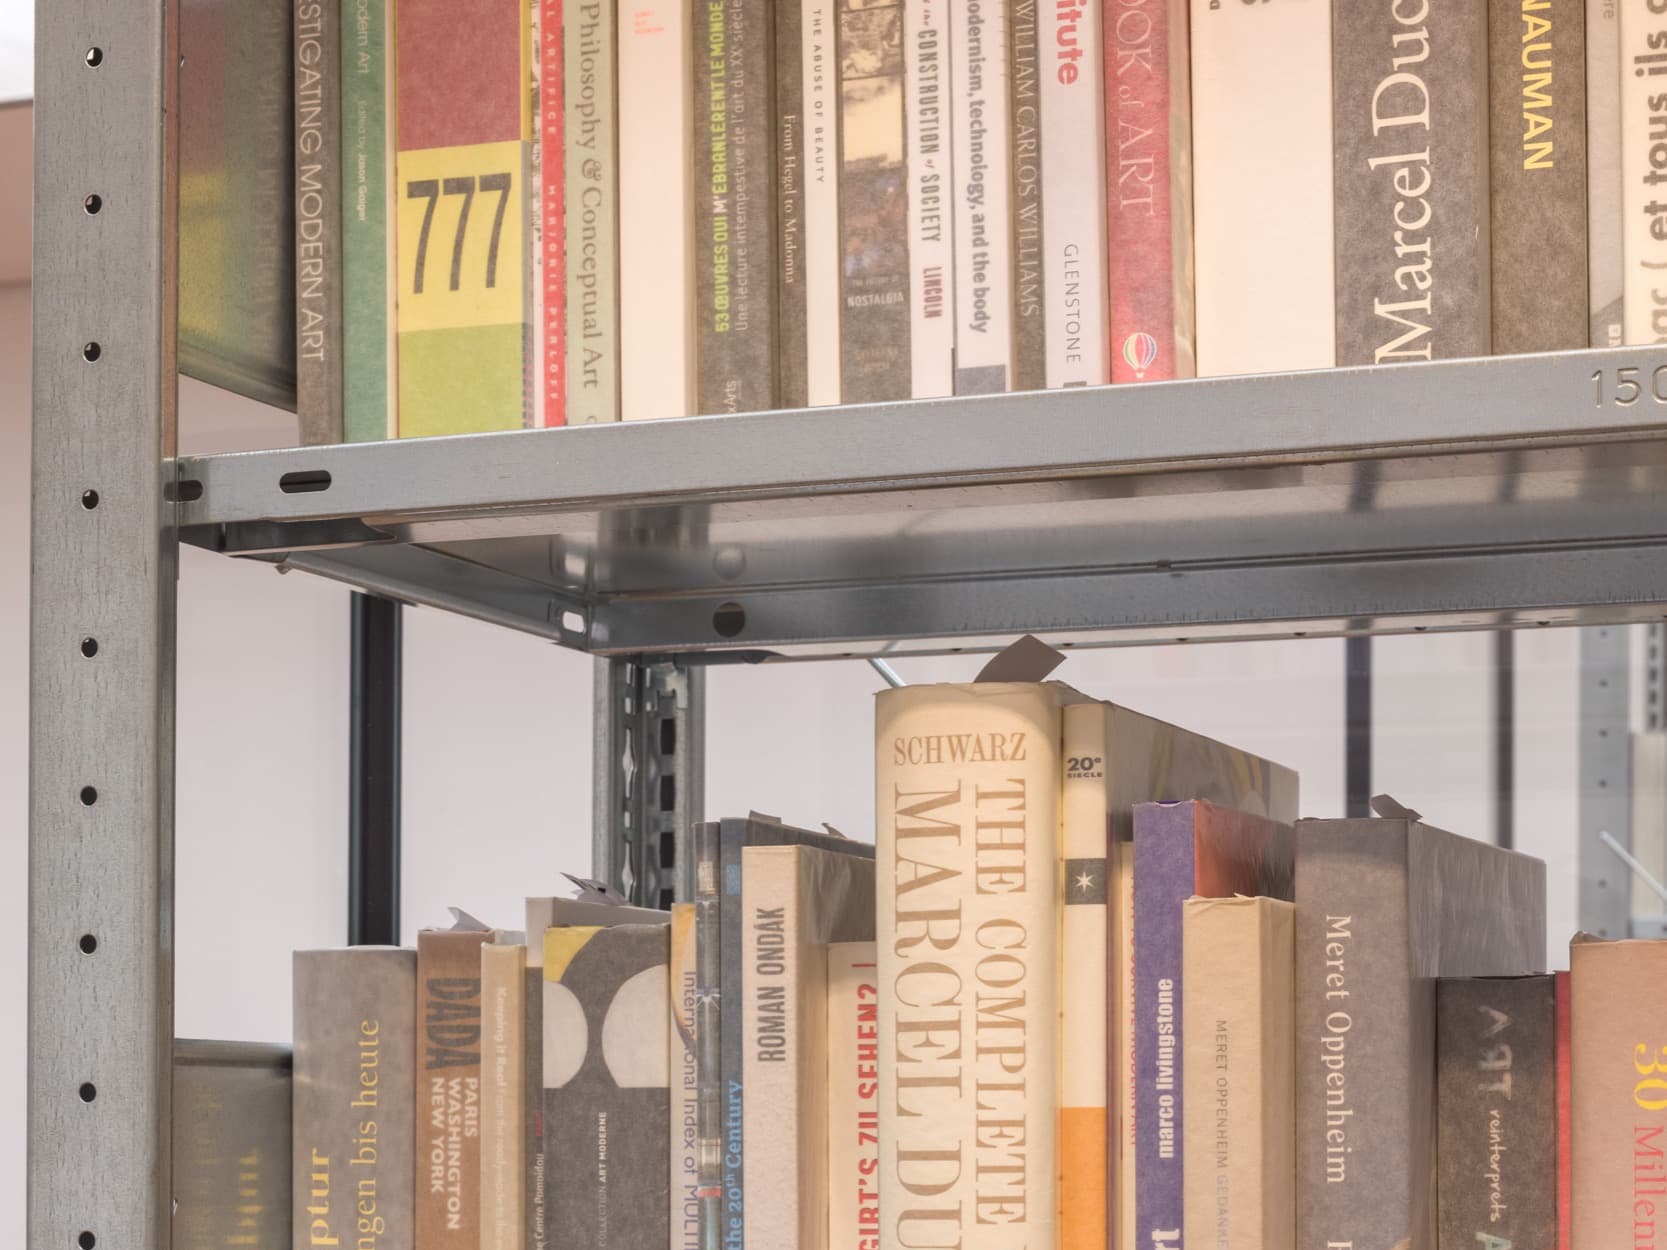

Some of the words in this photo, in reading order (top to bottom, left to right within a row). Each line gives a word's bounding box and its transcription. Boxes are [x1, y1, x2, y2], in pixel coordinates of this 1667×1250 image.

[708, 2, 725, 56] MONDE
[812, 9, 823, 37] THE
[965, 0, 986, 97] odernism,
[1015, 1, 1037, 97] WILLIAM
[576, 3, 602, 150] Philosophy
[709, 60, 725, 77] LE
[730, 70, 744, 89] du
[812, 45, 823, 93] ABUSE
[918, 29, 940, 155] CONSTRUCTION
[731, 127, 745, 146] de
[784, 114, 797, 150] From
[813, 100, 823, 119] OF
[582, 158, 602, 182] &
[782, 155, 798, 195] Hegel
[814, 127, 825, 183] BEAUTY
[965, 100, 988, 210] technology,
[1016, 106, 1038, 197] CARLOS
[733, 151, 749, 245] intempestive
[784, 199, 797, 213] to
[920, 174, 942, 243] SOCIETY
[300, 165, 324, 299] MODERN
[406, 173, 511, 294] 777
[713, 216, 727, 242] QUI
[783, 218, 798, 284] Madonna
[971, 214, 990, 248] and
[1367, 147, 1432, 365] Marcel
[577, 187, 602, 340] Conceptual
[734, 249, 748, 300] lecture
[972, 252, 991, 284] the
[1018, 203, 1040, 317] WILLIAMS
[714, 313, 729, 332] 53
[735, 303, 748, 331] Une
[847, 291, 905, 308] NOSTALGIA
[969, 288, 990, 334] body
[1064, 243, 1081, 364] GLENSTONE
[302, 308, 325, 361] ART
[583, 347, 603, 389] Art
[894, 731, 1028, 767] SCHWARZ
[975, 778, 1027, 896] THE
[894, 778, 963, 1118] MARCEL
[1326, 913, 1353, 1001] Meret
[425, 977, 481, 1071] DADA
[756, 986, 787, 1063] ROMAN
[1156, 978, 1177, 1091] livingstone
[1215, 1019, 1228, 1072] MERET
[350, 1019, 380, 1108] heute
[974, 918, 1028, 1225] COMPLETE
[430, 1077, 445, 1131] NEW
[464, 1077, 478, 1137] PARIS
[725, 1080, 743, 1169] Century
[1215, 1077, 1229, 1169] OPPENHEIM
[1320, 1011, 1353, 1184] Oppenheim
[349, 1120, 378, 1165] bis
[446, 1077, 461, 1230] WASHINGTON
[599, 1111, 608, 1161] MODERNE
[1157, 1094, 1174, 1159] marco
[430, 1136, 445, 1195] YORK
[599, 1162, 608, 1184] ART
[725, 1173, 743, 1213] 20th
[724, 1217, 742, 1250] the
